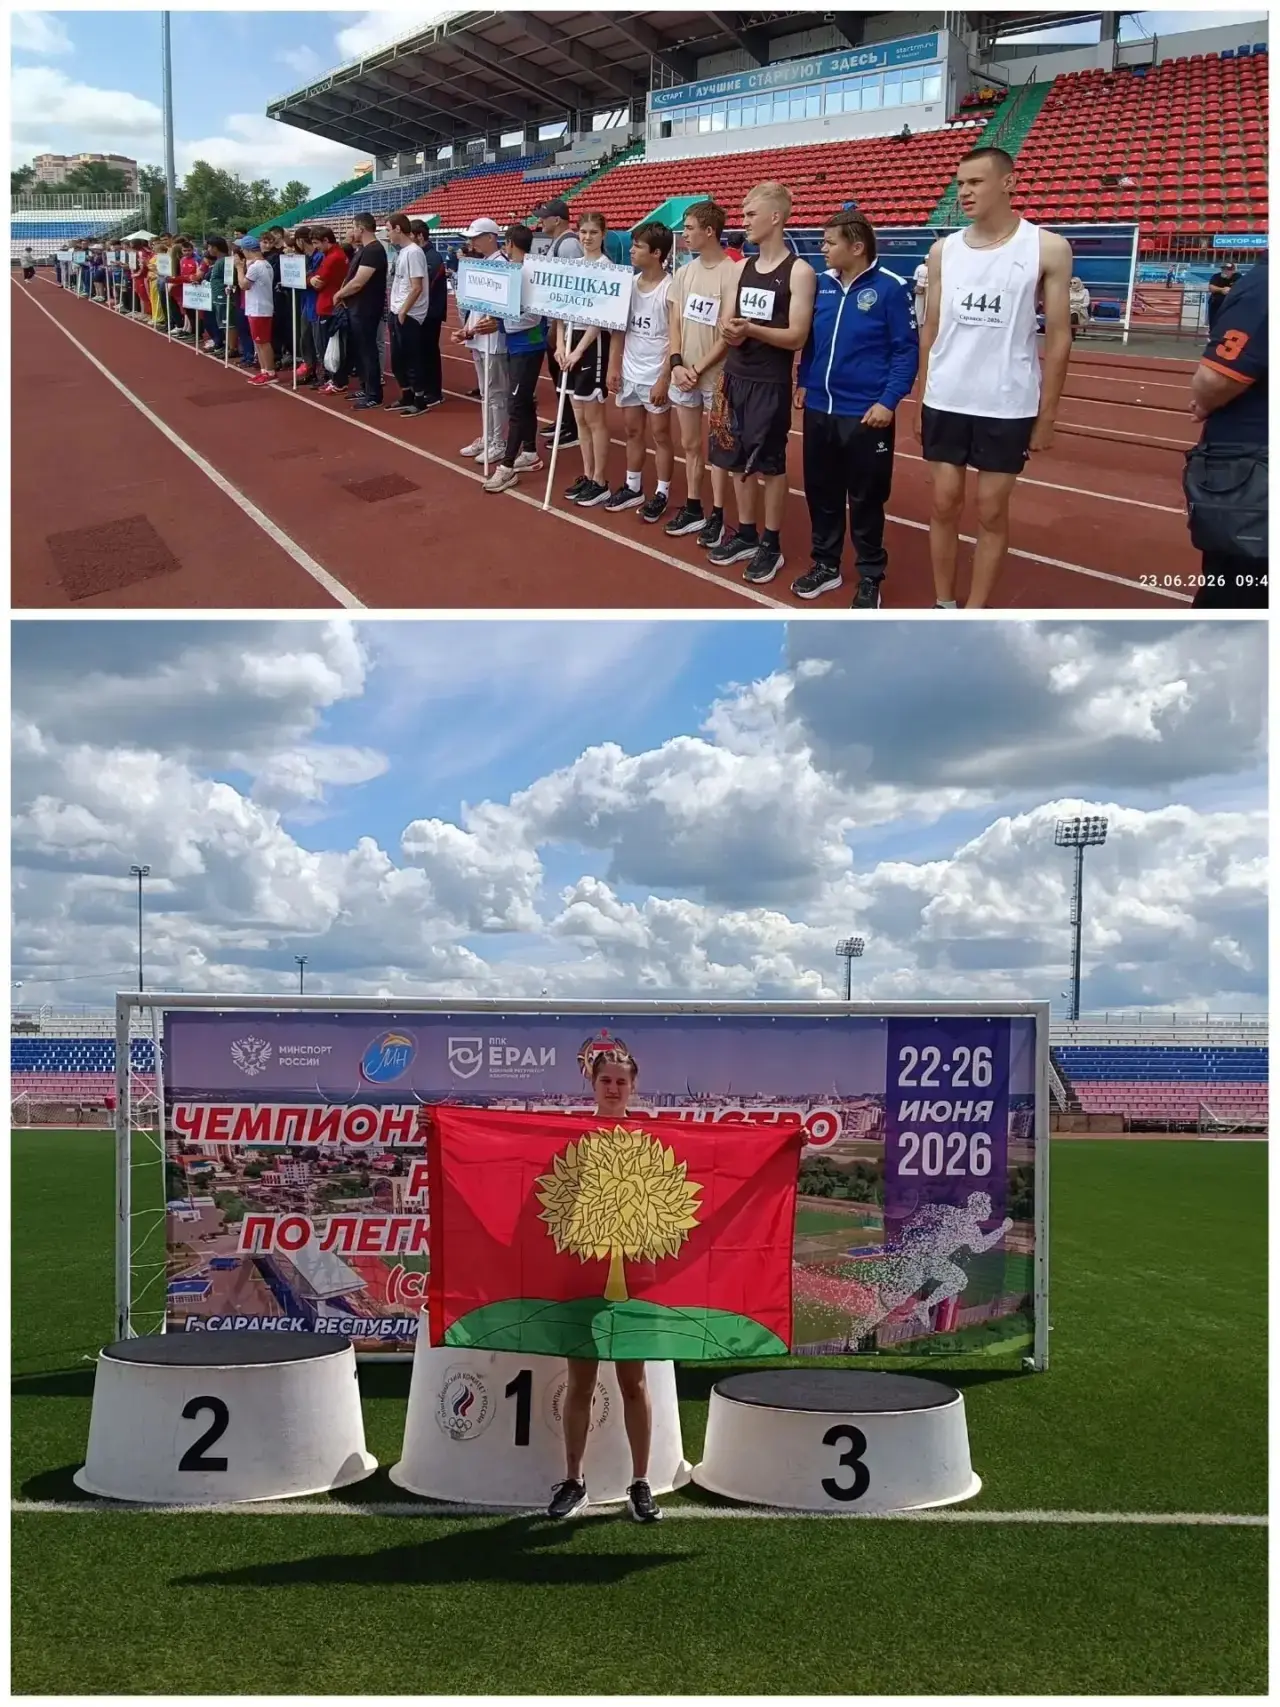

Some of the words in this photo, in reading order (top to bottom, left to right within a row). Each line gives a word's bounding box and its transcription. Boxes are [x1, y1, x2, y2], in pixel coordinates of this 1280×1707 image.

[695, 80, 741, 97] ЛУЧШИЕ
[748, 62, 822, 88] СТАРТУЮТ
[831, 52, 878, 71] ЗДЕСЬ
[661, 91, 683, 101] СТАРТ
[530, 270, 621, 297] ЛИПЕЦКАЯ
[549, 292, 594, 308] ОБЛАСТЬ
[689, 298, 714, 315] 447
[742, 291, 768, 309] 446
[960, 292, 1002, 313] 444
[630, 315, 651, 330] 445
[1216, 329, 1250, 360] 3
[278, 1045, 333, 1054] МИНСПОРТ
[489, 1037, 507, 1045] ППК
[278, 1057, 320, 1066] РОССИИ
[489, 1046, 556, 1066] ЕРАИ
[898, 1100, 994, 1122] ИЮНЯ
[898, 1131, 992, 1176] 2026
[240, 1215, 312, 1252] ПО
[462, 1372, 487, 1394] КОМИТЕТ
[505, 1369, 532, 1446] 1
[178, 1396, 229, 1472] 2
[821, 1424, 871, 1502] 3
